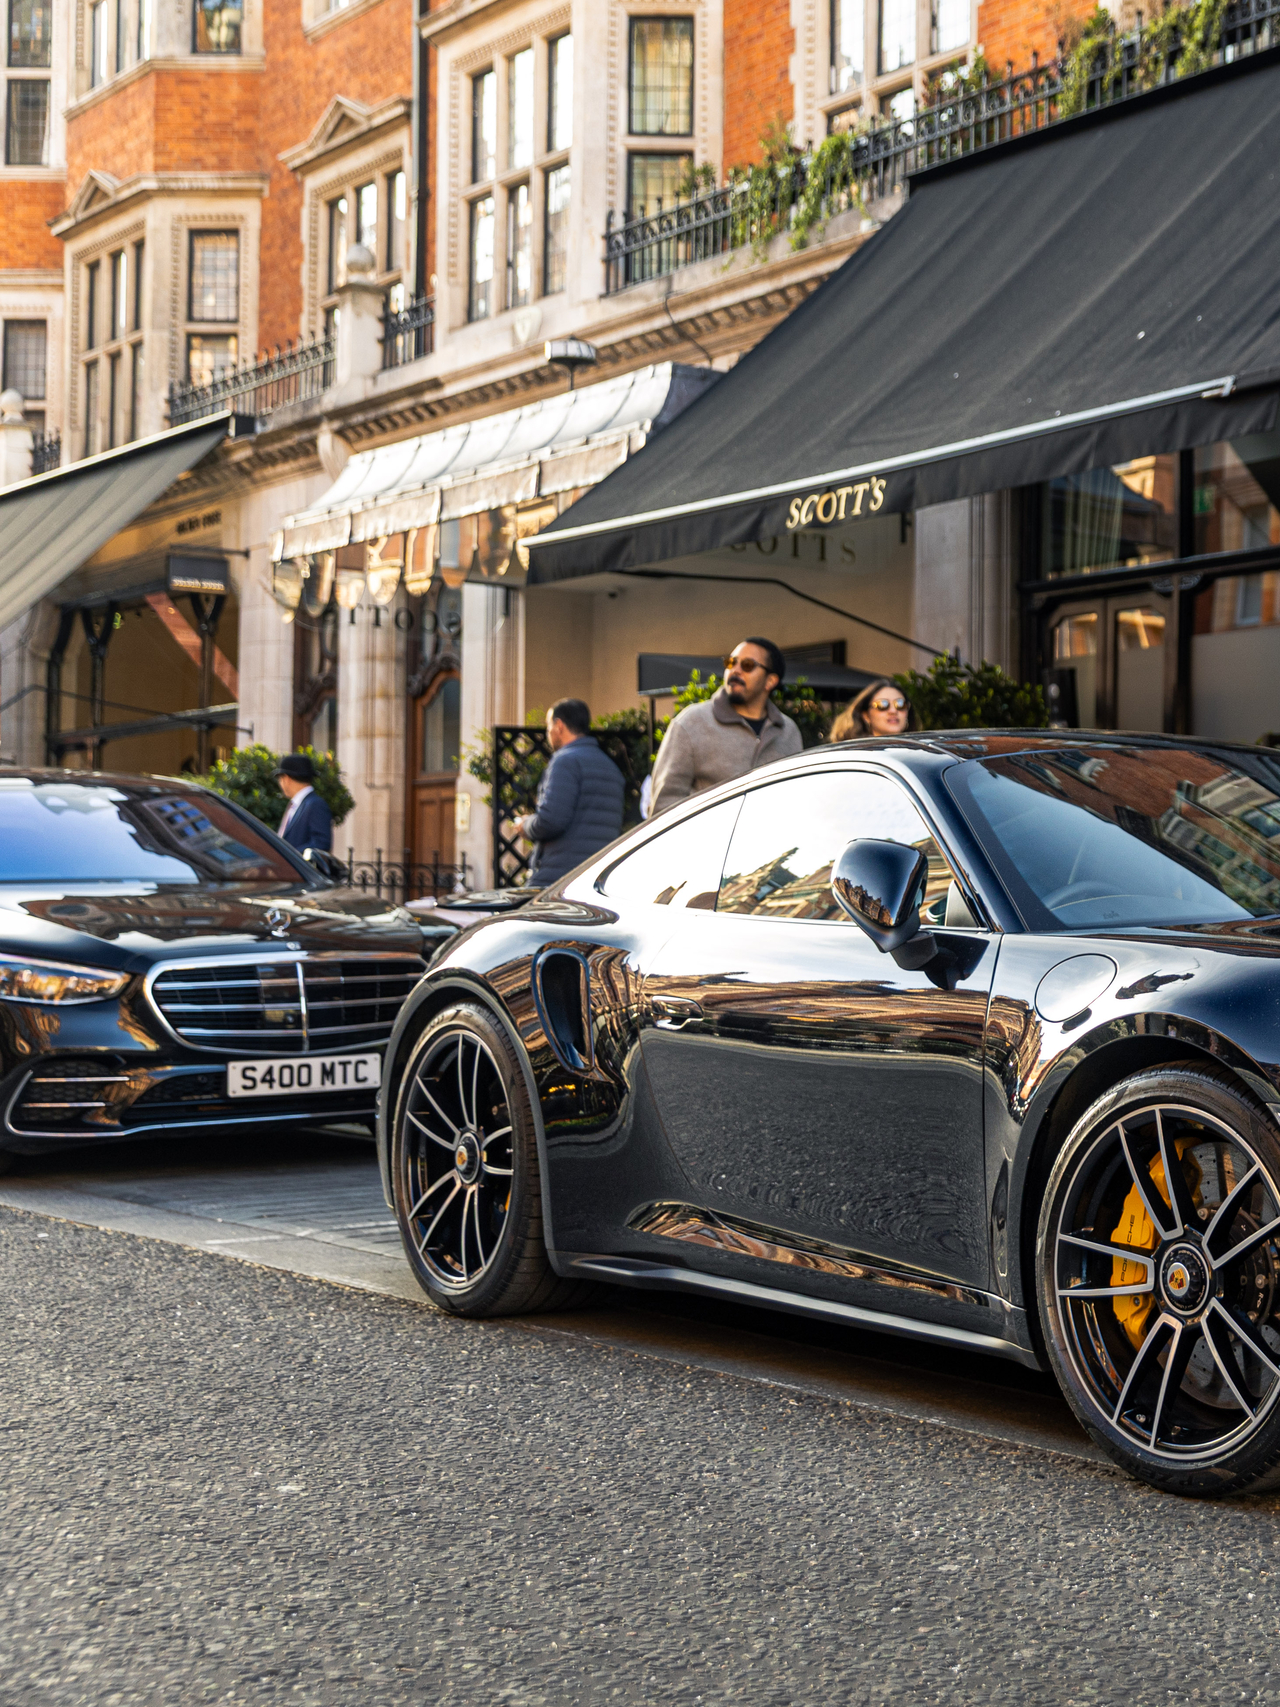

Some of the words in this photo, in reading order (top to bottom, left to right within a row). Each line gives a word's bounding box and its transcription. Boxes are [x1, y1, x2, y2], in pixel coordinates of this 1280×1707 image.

[785, 476, 887, 529] SCOTT'S
[241, 1063, 312, 1091] S400
[321, 1059, 369, 1086] MTC
